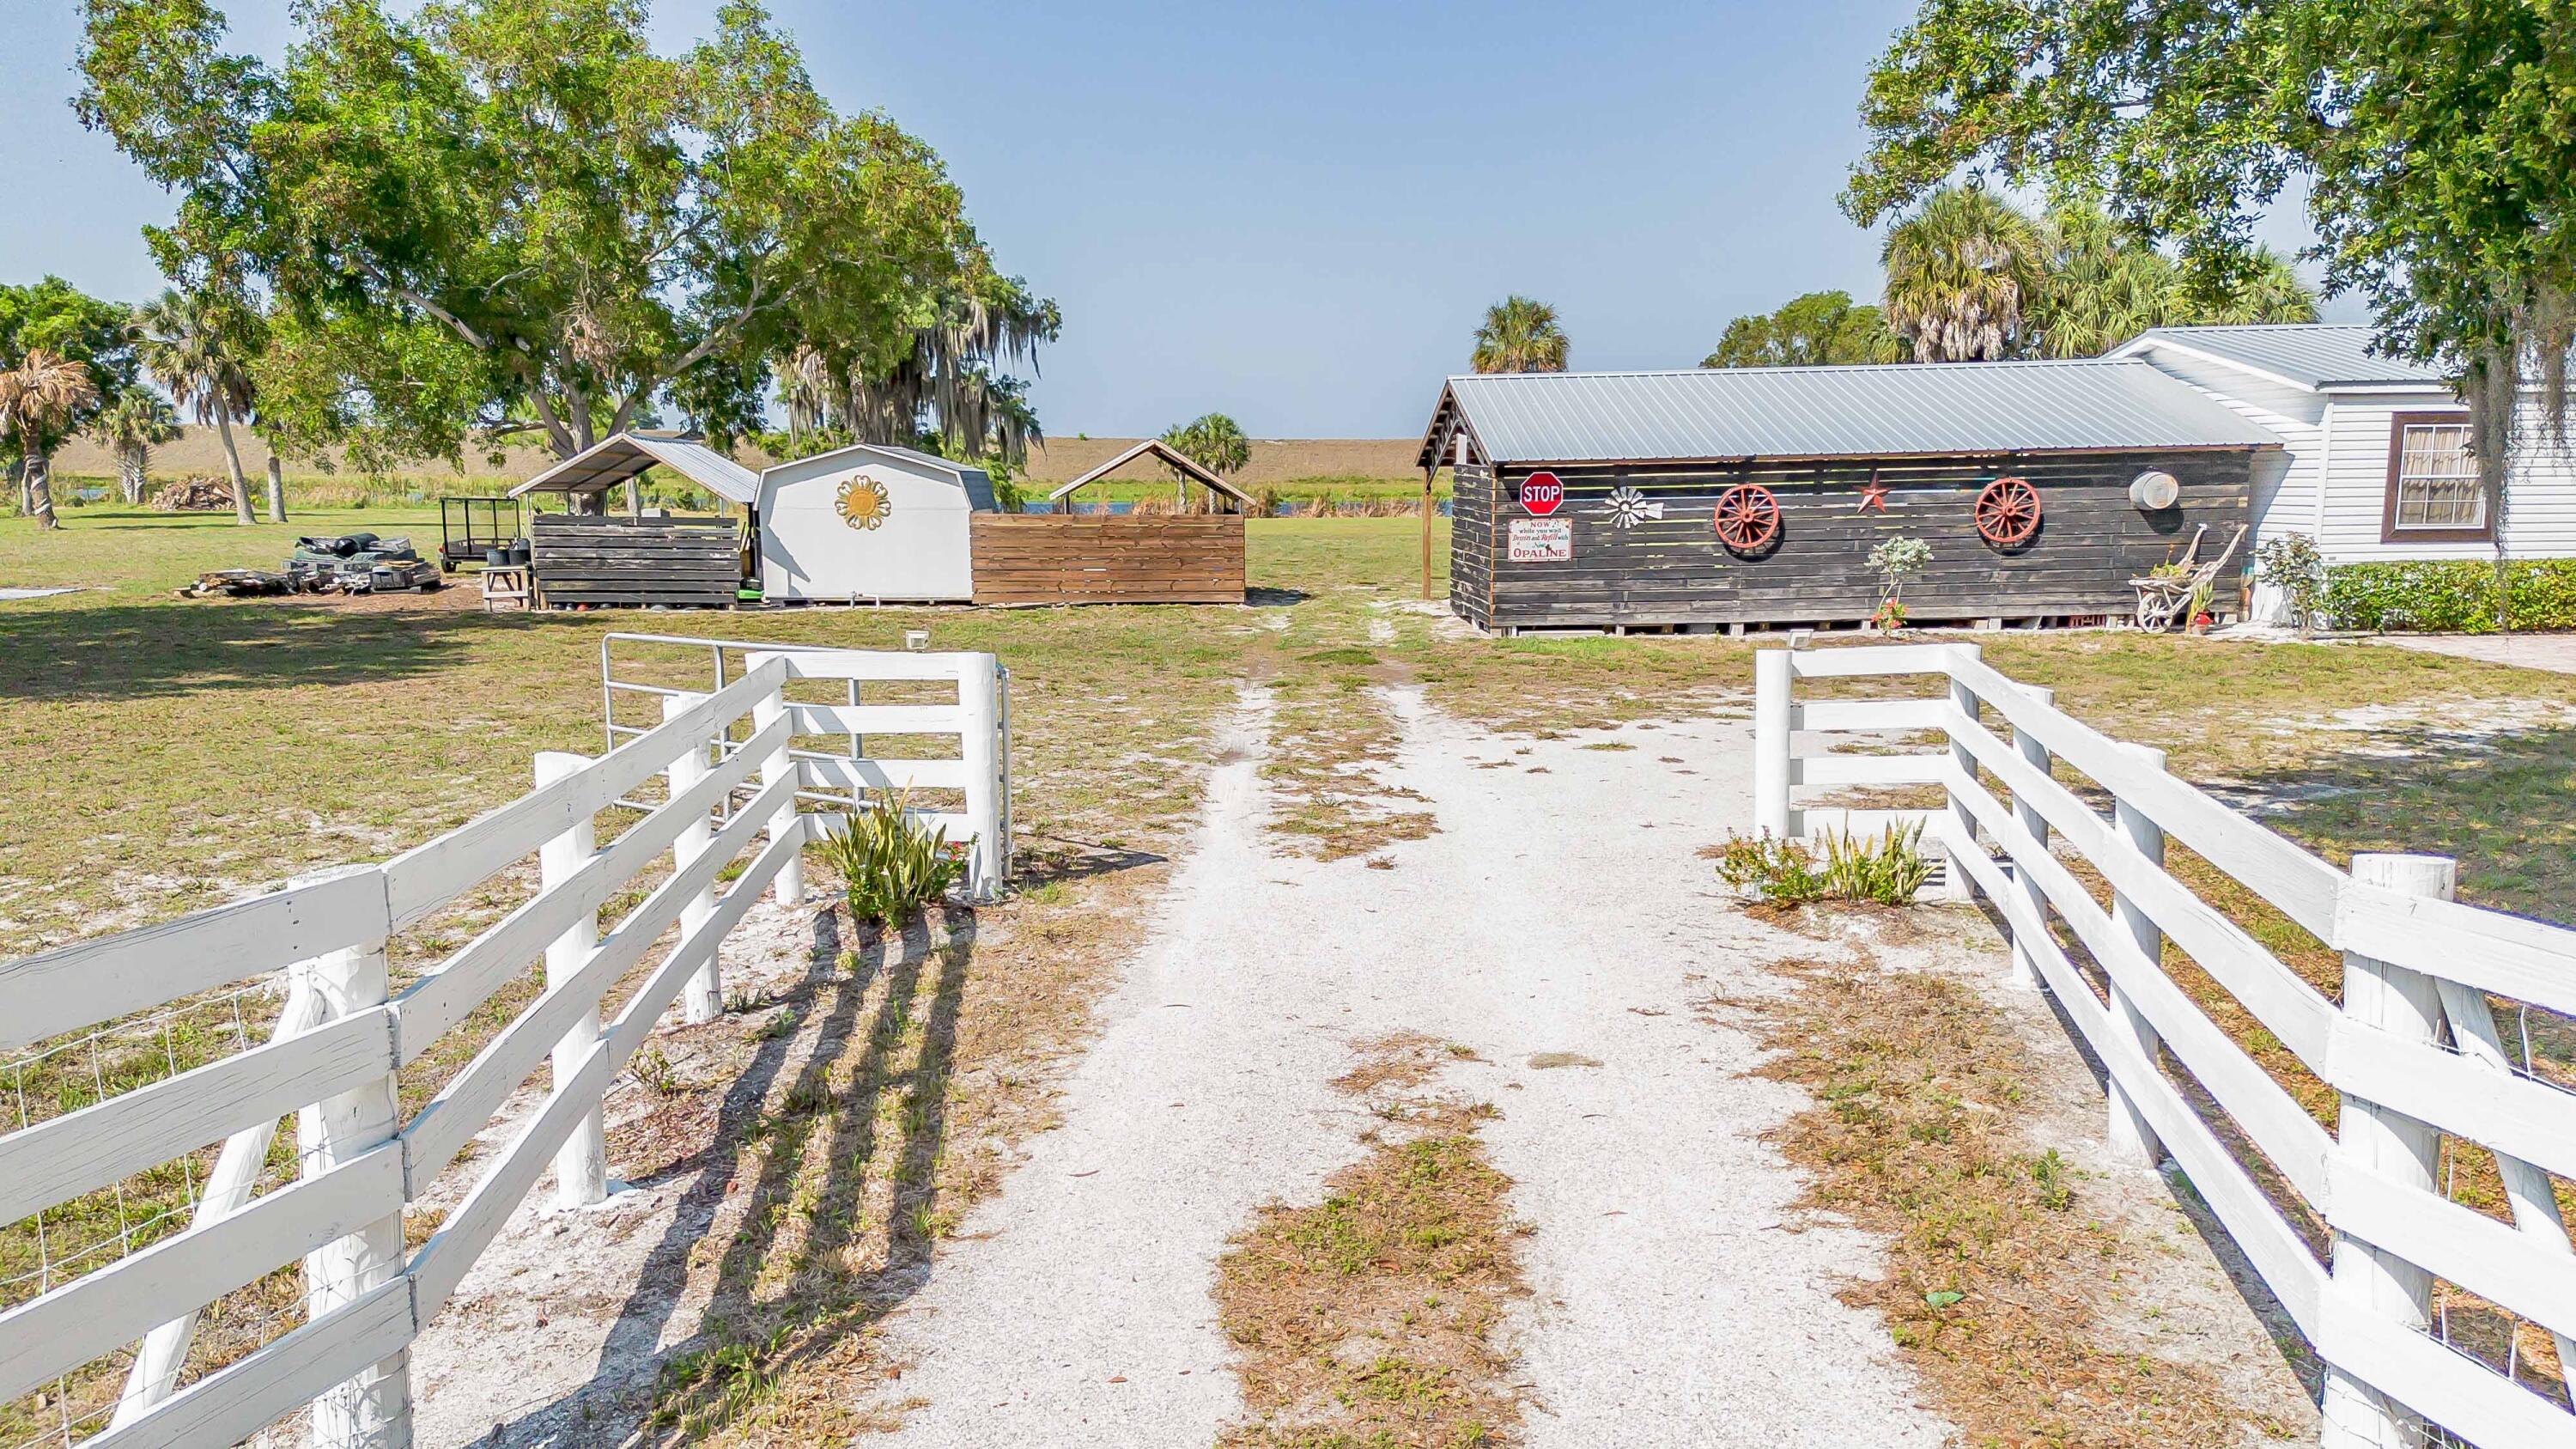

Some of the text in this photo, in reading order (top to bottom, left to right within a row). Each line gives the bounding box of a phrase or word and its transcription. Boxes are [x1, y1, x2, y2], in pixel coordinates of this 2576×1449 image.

[1523, 485, 1560, 502] STOP
[1540, 533, 1558, 542] Refill
[1513, 548, 1567, 557] OPALINE
